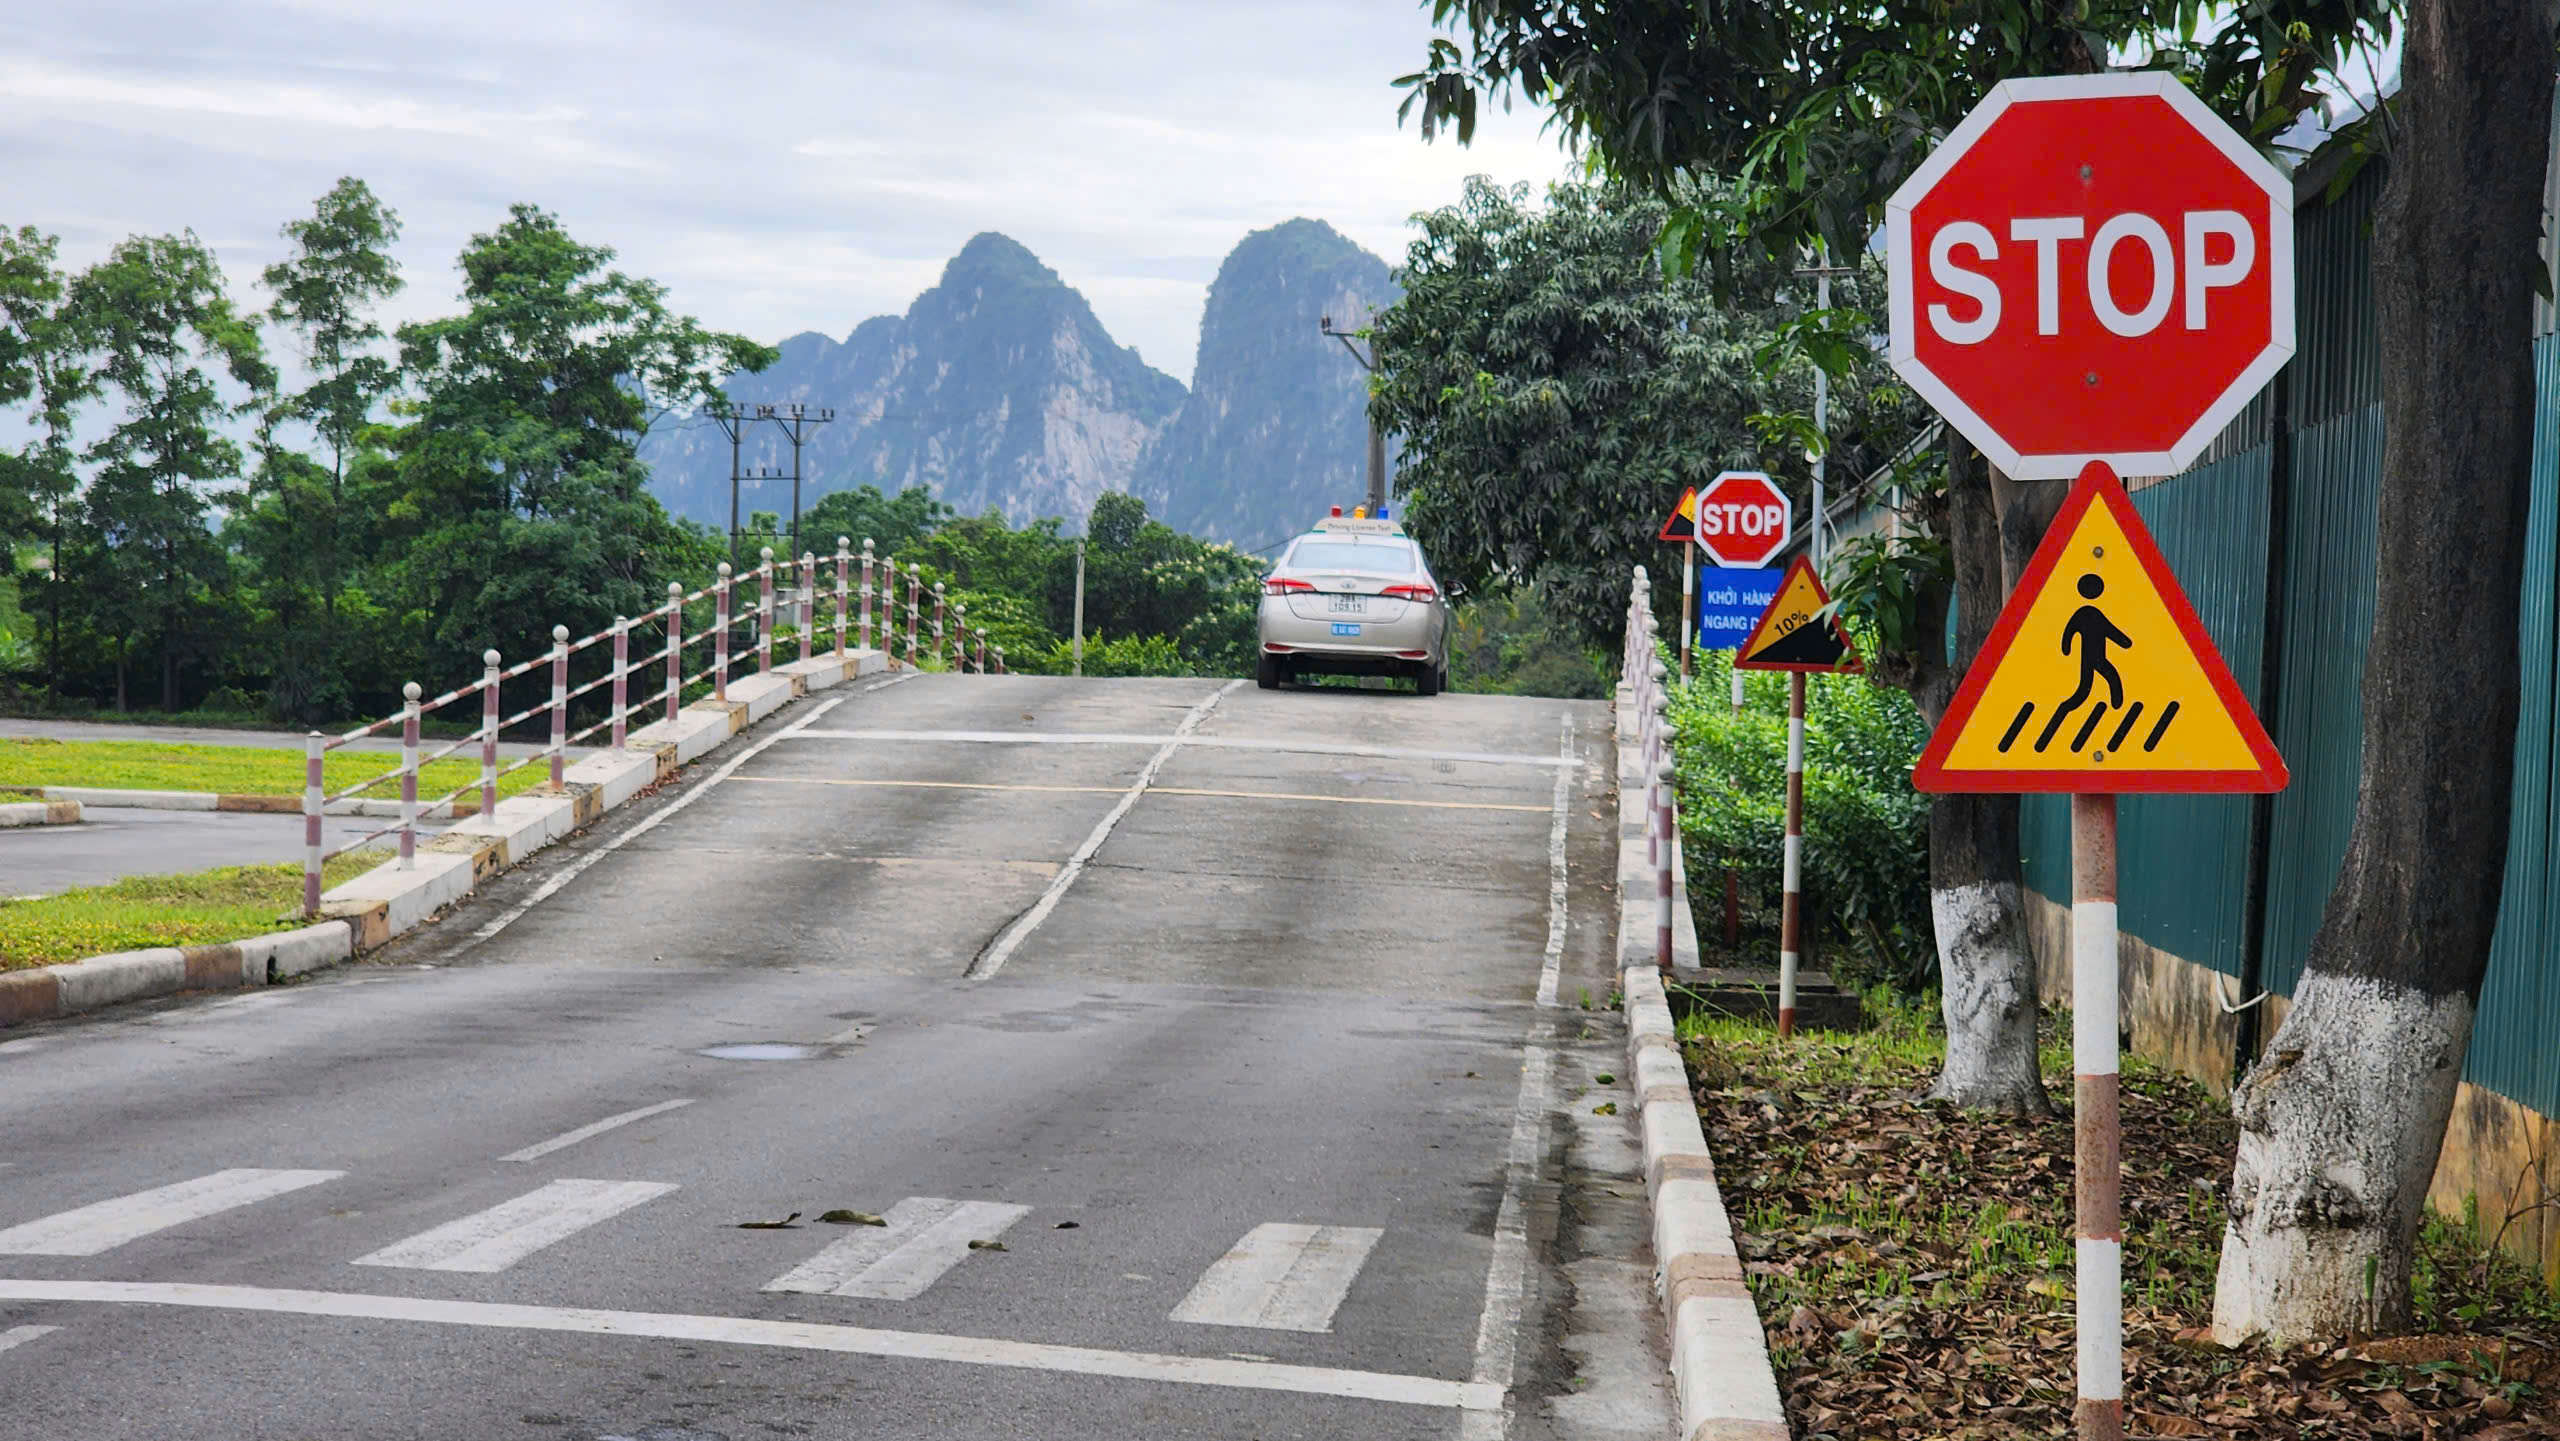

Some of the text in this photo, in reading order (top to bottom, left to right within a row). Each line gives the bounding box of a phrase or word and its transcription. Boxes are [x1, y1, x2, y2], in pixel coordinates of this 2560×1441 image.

[1927, 210, 2256, 345] STOP
[1703, 503, 1783, 536] STOP
[1703, 615, 1748, 630] NGANG
[1774, 609, 1809, 636] 10%
